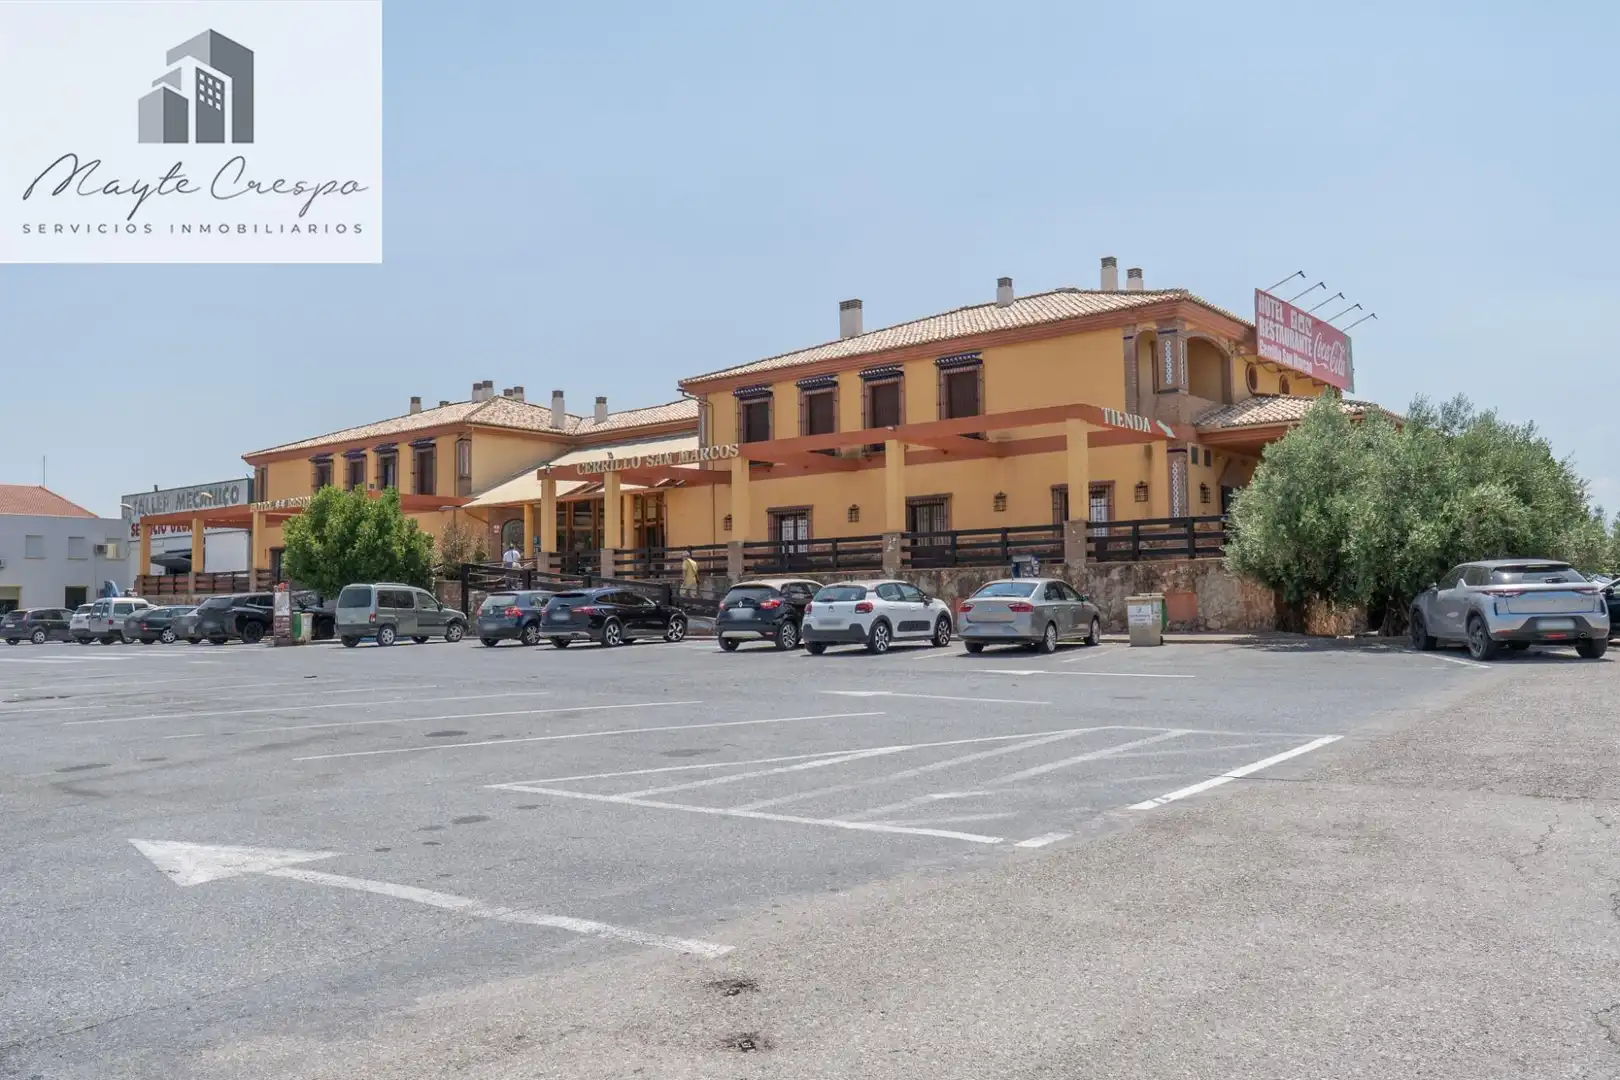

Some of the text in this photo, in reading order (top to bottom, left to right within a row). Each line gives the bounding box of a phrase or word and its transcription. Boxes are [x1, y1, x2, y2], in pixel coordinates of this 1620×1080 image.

[1258, 293, 1284, 322] HOTEL
[1258, 315, 1313, 358] RESTAURANTE
[1100, 407, 1152, 433] TIENDA
[576, 443, 740, 476] CERRILLO SAN MARCOS
[133, 492, 170, 516] TALLER
